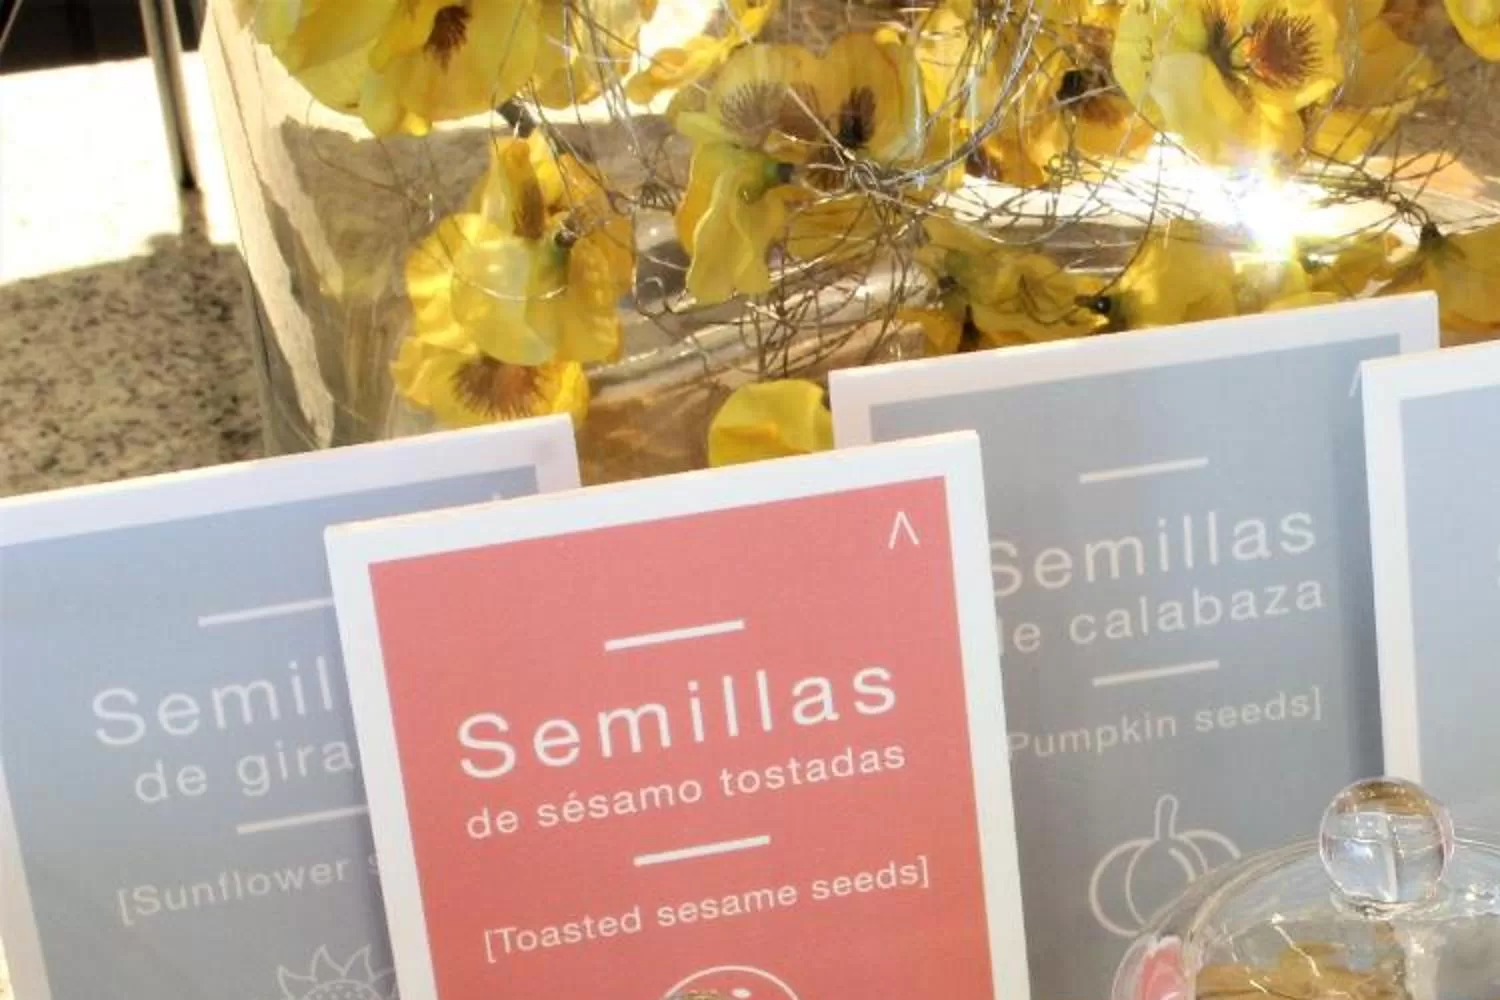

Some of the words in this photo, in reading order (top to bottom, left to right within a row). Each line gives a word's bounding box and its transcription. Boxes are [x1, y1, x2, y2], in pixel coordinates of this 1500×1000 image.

[990, 511, 1317, 597] Semillas
[997, 616, 1042, 656] e
[1069, 579, 1324, 646] calabaza
[91, 655, 333, 748] Semil
[457, 666, 899, 780] Semillas
[1195, 686, 1323, 734] seeds]
[134, 759, 208, 804] de
[236, 738, 356, 799] gira
[466, 806, 519, 842] de
[536, 780, 703, 829] sésamo
[720, 740, 906, 798] tostadas
[117, 857, 352, 926] [Sunflower
[483, 904, 642, 963] [Toasted
[656, 882, 798, 928] sesame
[811, 854, 930, 902] seeds]
